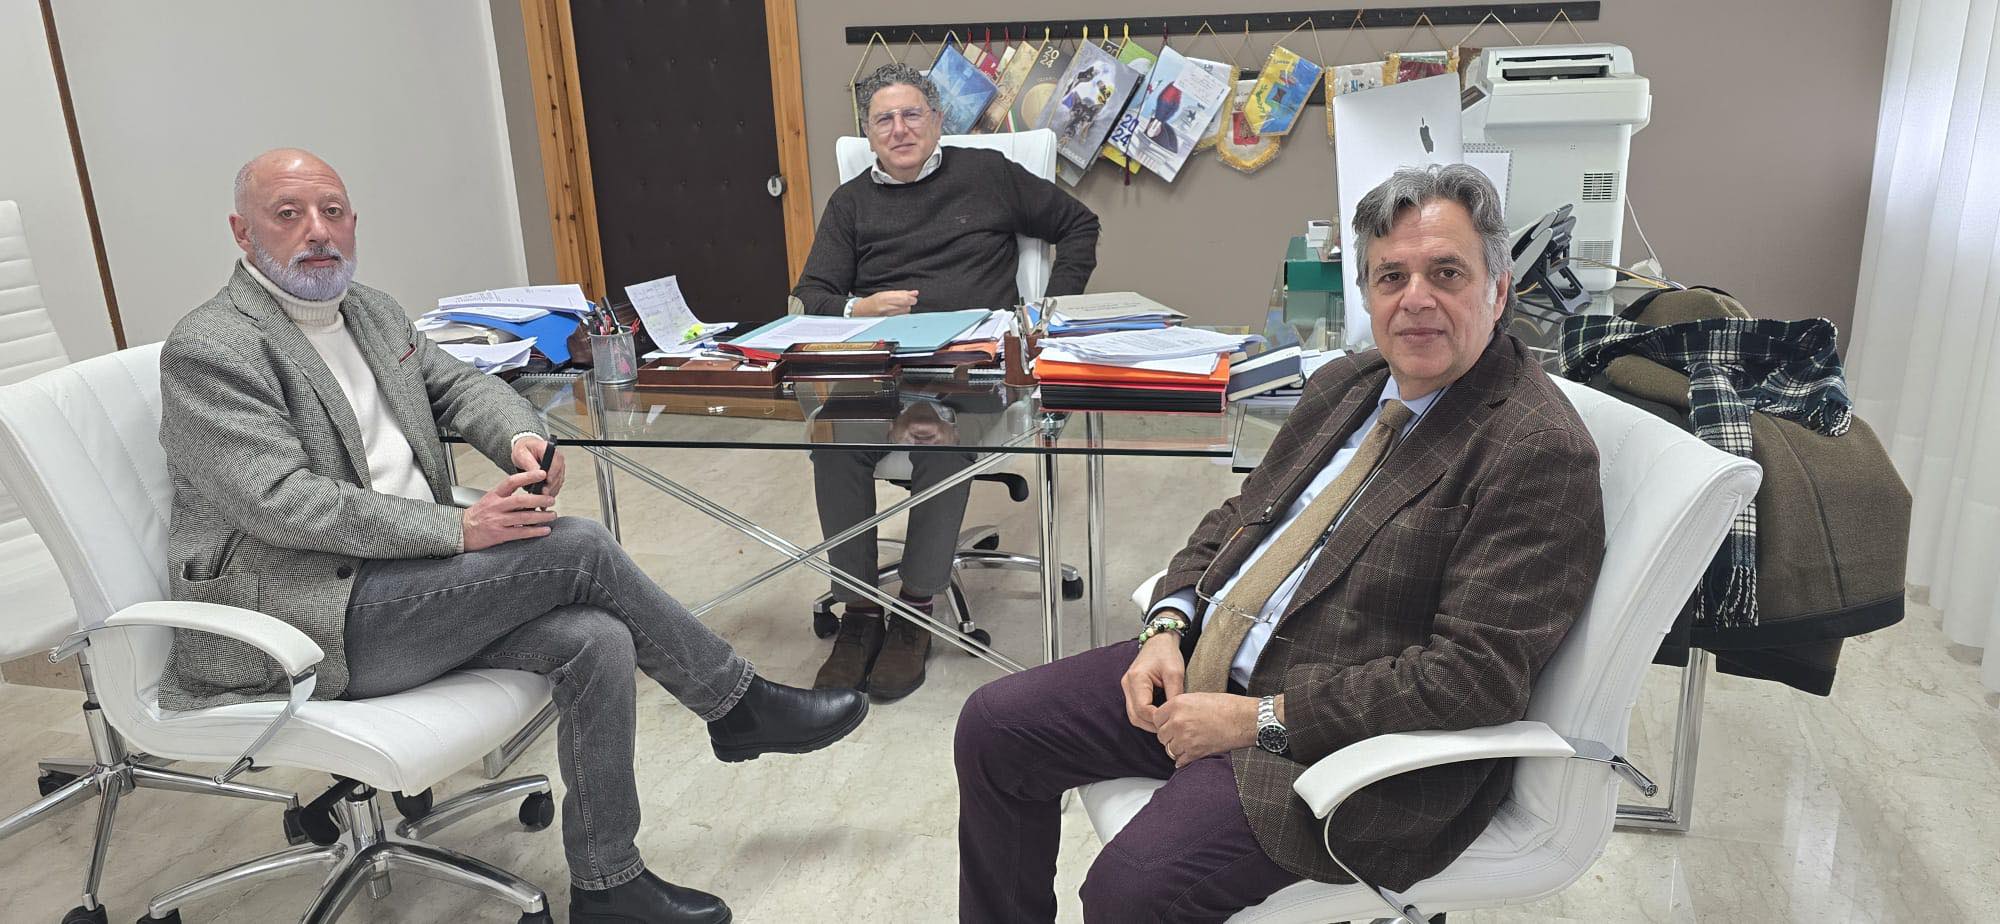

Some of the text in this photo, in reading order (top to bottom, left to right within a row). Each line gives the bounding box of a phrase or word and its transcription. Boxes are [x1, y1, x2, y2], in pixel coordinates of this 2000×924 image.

[1040, 54, 1054, 68] 24
[1044, 46, 1060, 60] 20
[1120, 114, 1139, 132] 20
[1111, 128, 1131, 146] 24
